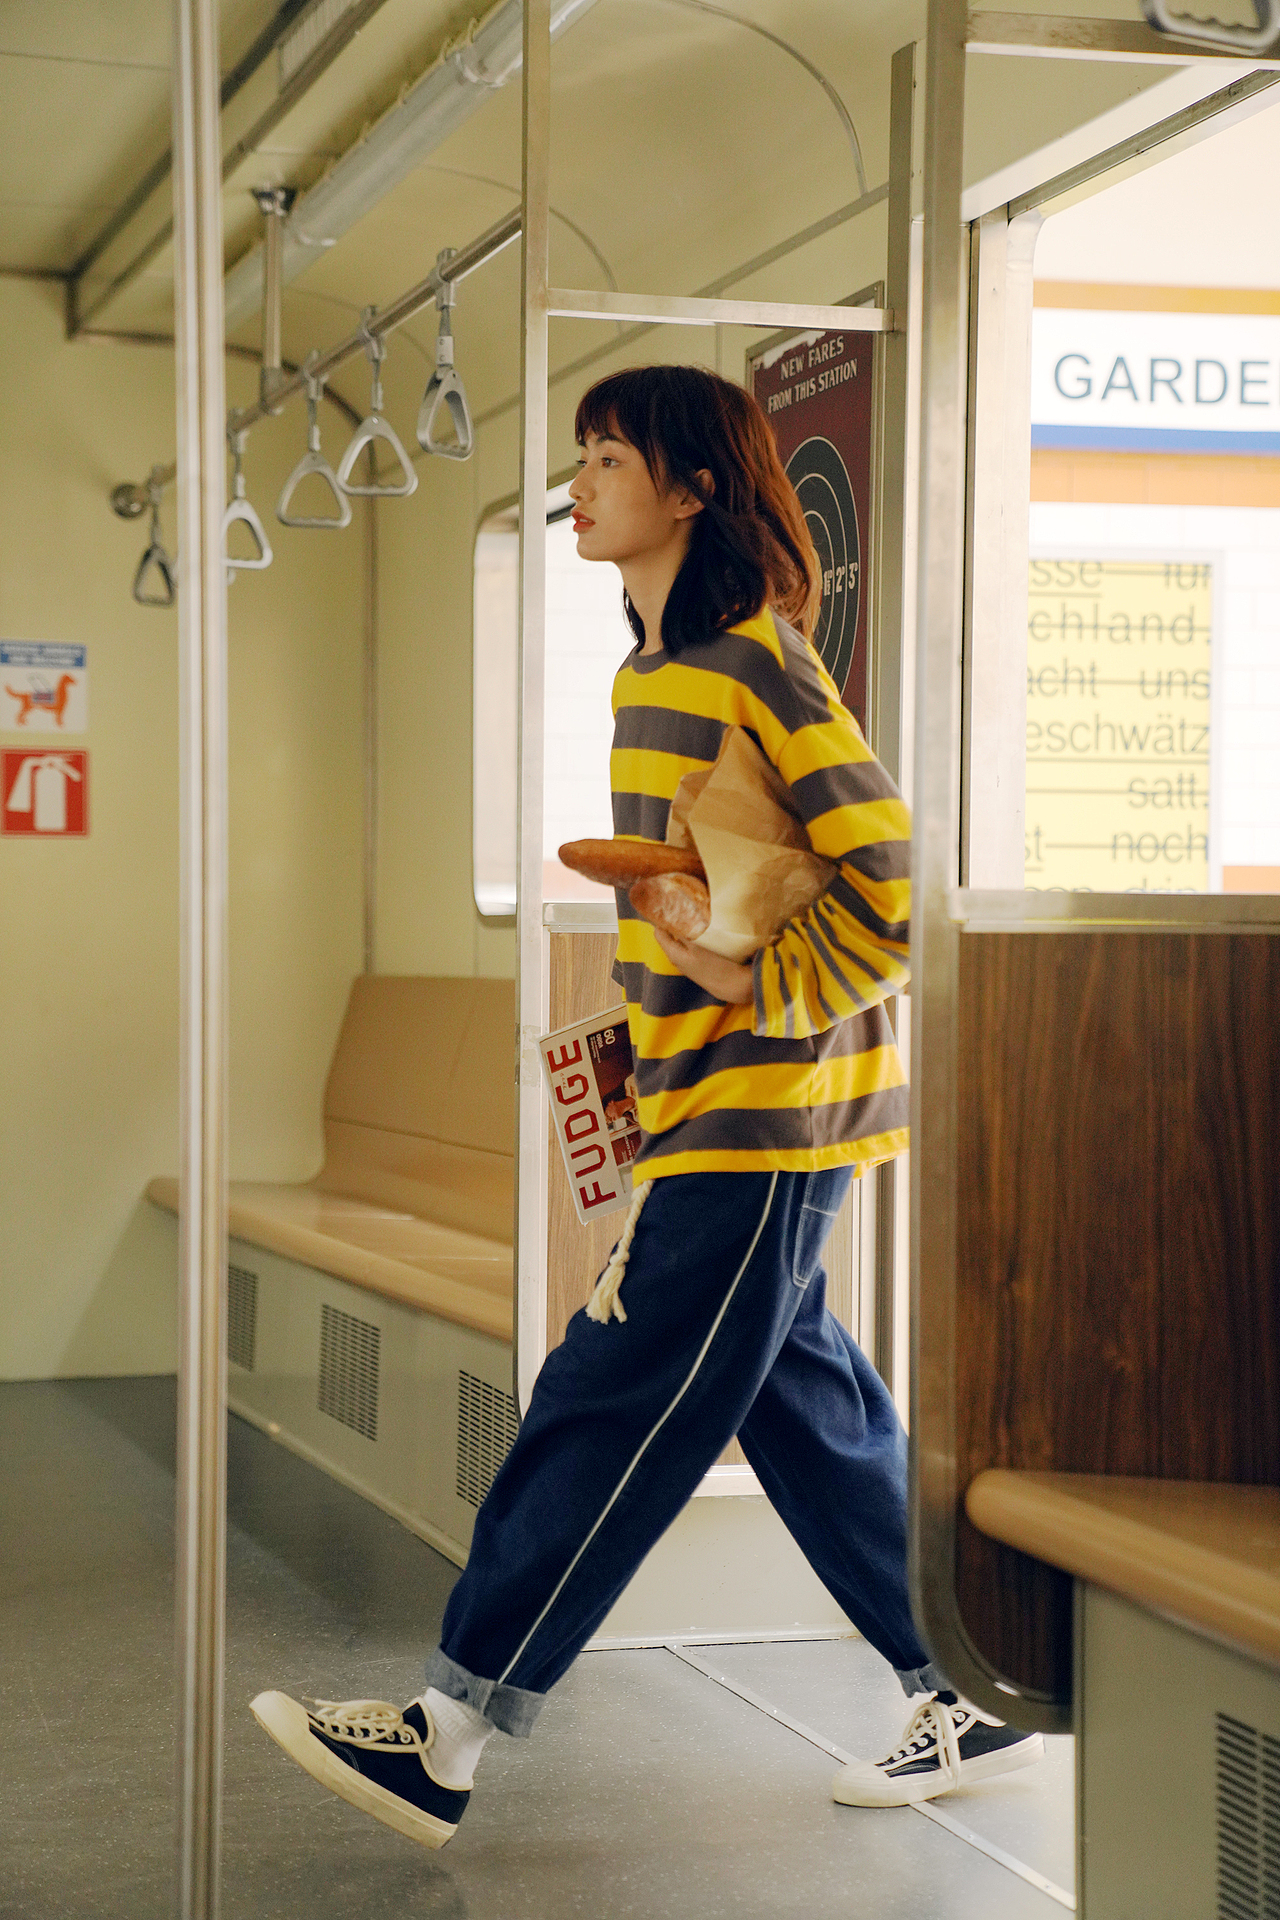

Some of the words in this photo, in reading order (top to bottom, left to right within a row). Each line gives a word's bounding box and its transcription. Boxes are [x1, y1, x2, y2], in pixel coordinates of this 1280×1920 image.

[781, 354, 805, 381] NEW
[808, 335, 845, 368] FARES
[1054, 354, 1280, 406] GARDE
[767, 387, 792, 415] FROM
[794, 378, 817, 402] THIS
[818, 358, 858, 392] STATION
[1139, 669, 1210, 700] uns
[1128, 772, 1209, 808] satt.
[1111, 823, 1209, 863] noch
[546, 1039, 617, 1210] FUDGE
